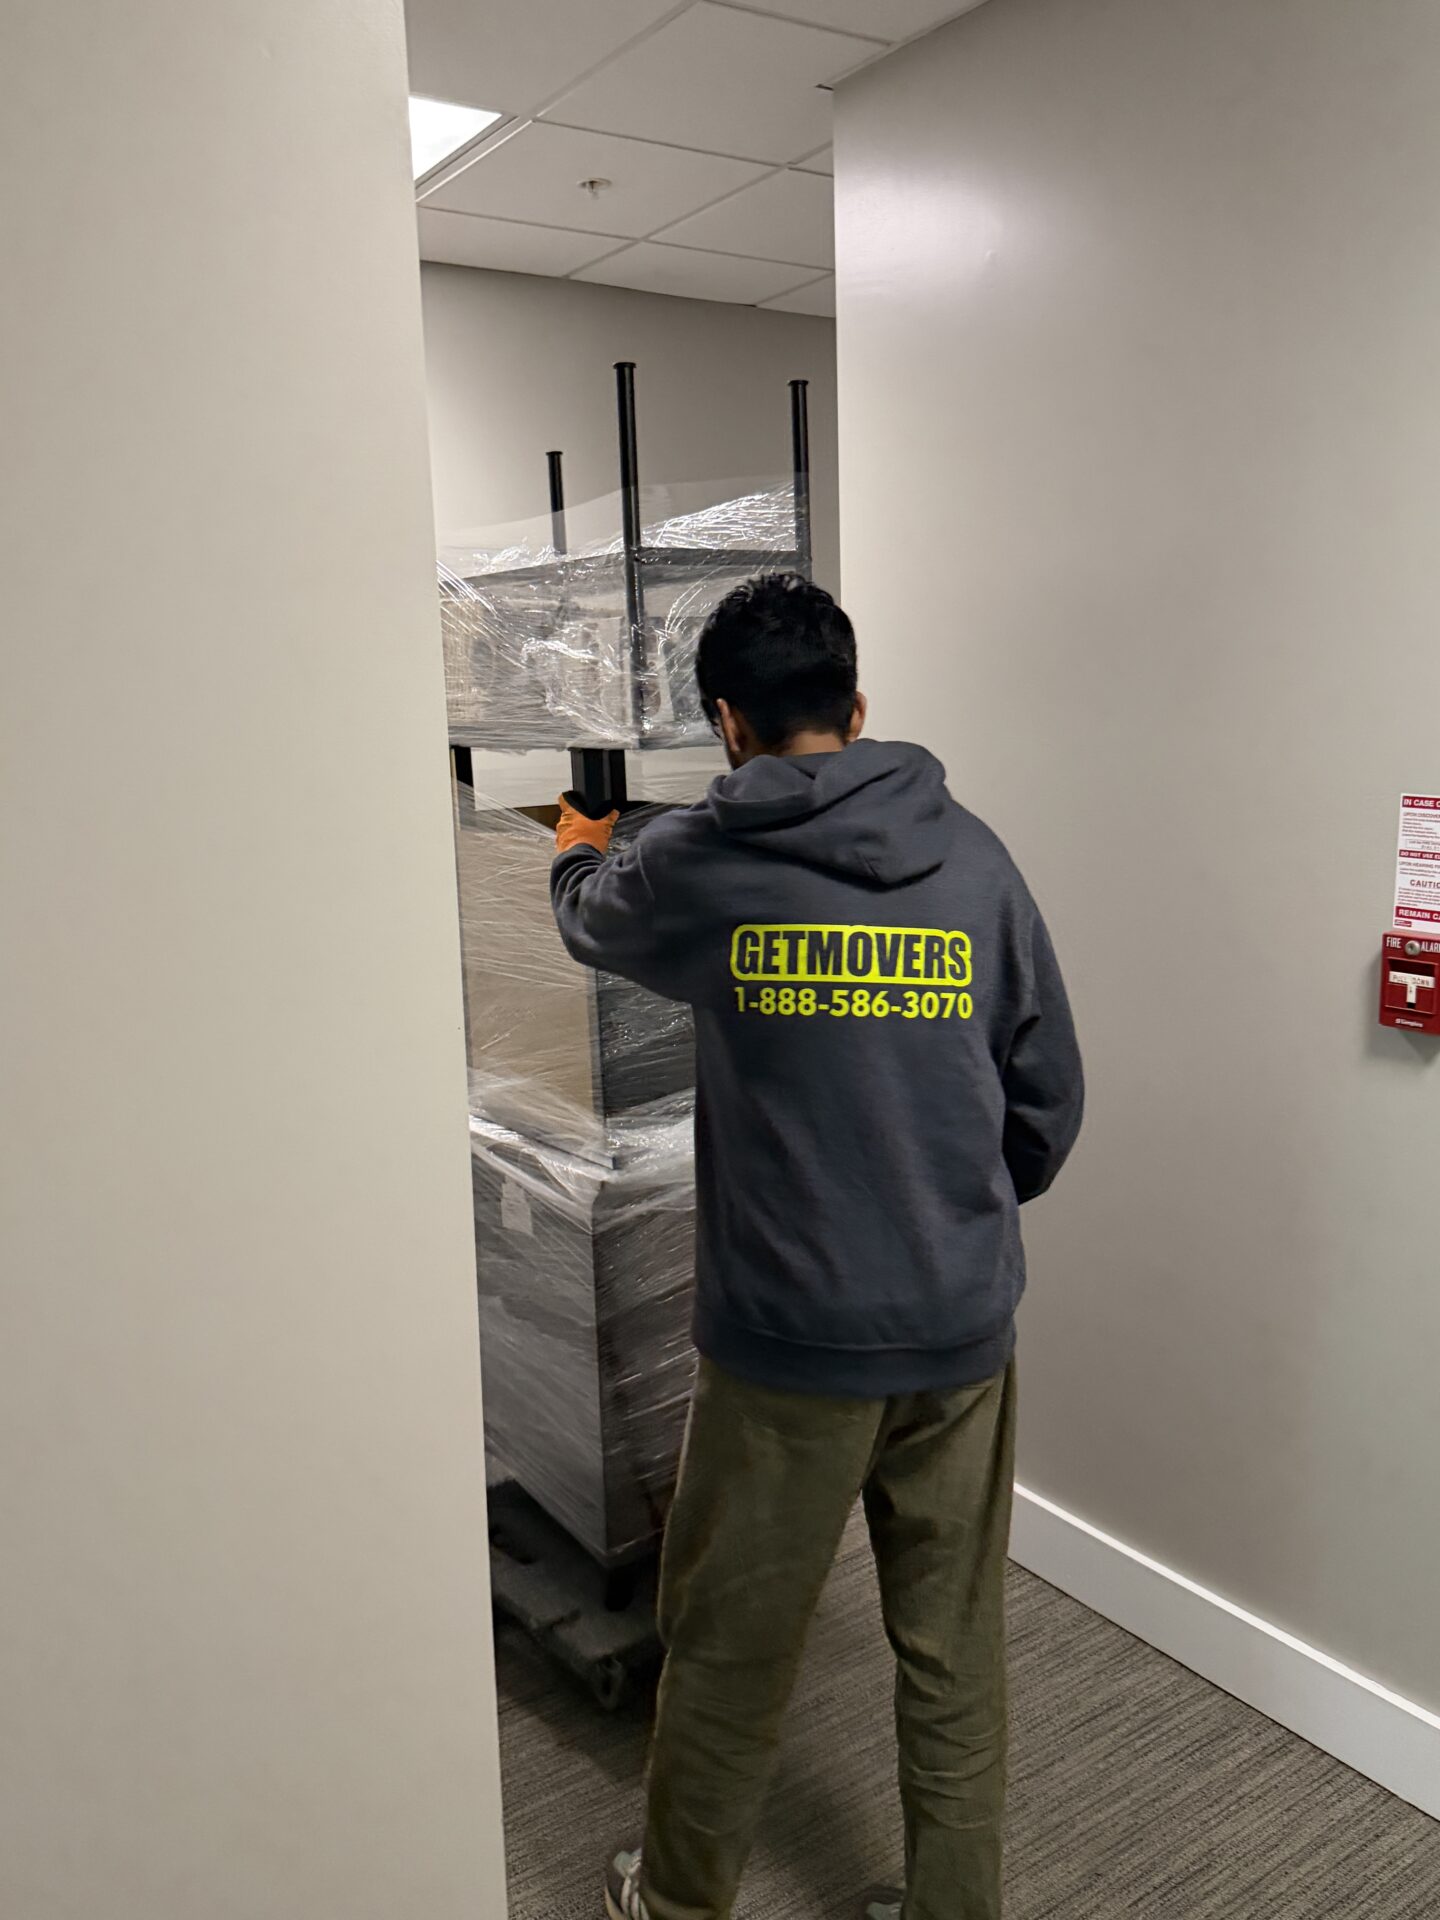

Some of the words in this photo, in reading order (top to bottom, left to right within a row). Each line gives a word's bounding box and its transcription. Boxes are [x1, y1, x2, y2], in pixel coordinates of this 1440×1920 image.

[1403, 798, 1412, 806] IN
[1413, 799, 1435, 808] CASE
[1410, 879, 1440, 889] CAUTIO
[1399, 909, 1431, 919] REMAIN
[1386, 937, 1401, 949] FIRE
[735, 928, 967, 981] GETMOVERS
[734, 986, 973, 1019] 1-888-586-3070
